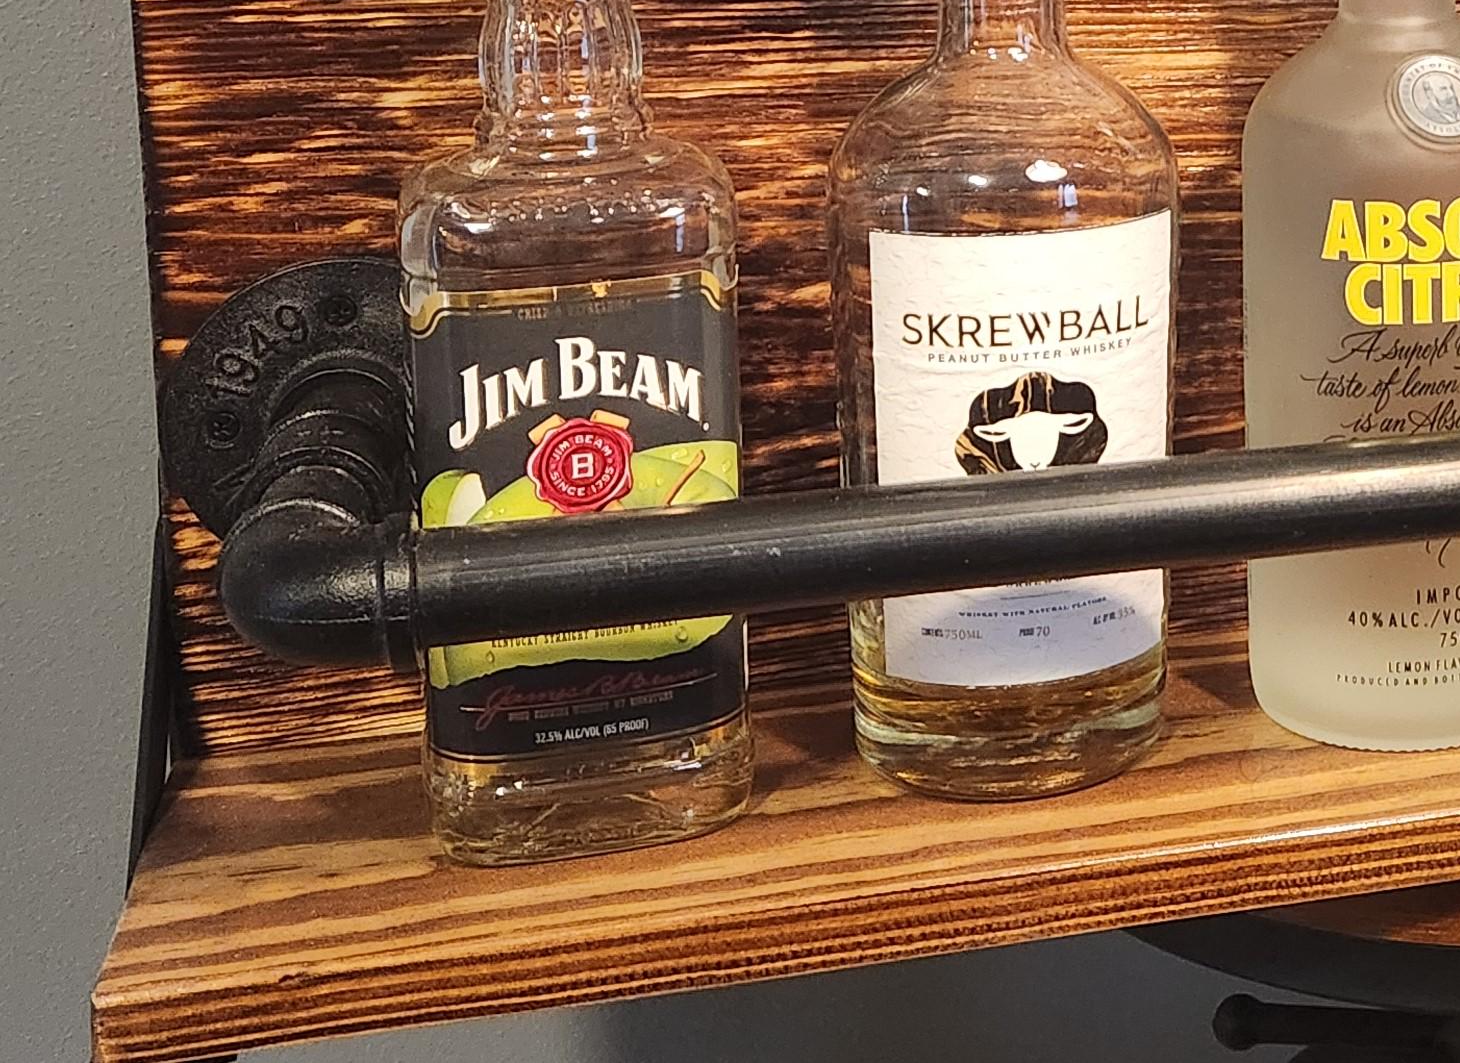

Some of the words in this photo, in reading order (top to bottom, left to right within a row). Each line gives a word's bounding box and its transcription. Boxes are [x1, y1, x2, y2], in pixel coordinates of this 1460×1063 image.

[902, 295, 1149, 347] SKREWBALL
[927, 352, 990, 364] PEANUT
[999, 349, 1062, 363] BUTTER
[1070, 337, 1133, 357] WHISKEY
[1327, 327, 1388, 364] A
[1375, 324, 1458, 368] superb
[449, 358, 551, 450] JIM
[554, 336, 702, 422] BEAM
[1300, 371, 1367, 399] taste
[1367, 367, 1402, 414] of
[1341, 410, 1378, 434] is
[1379, 416, 1408, 434] an
[552, 440, 571, 461] JIM
[574, 434, 613, 457] BEAM
[571, 452, 595, 480] B
[549, 471, 586, 496] SINCE
[591, 466, 614, 494] 1795
[1036, 627, 1051, 638] 70
[1336, 674, 1400, 686] PRODUCED
[1405, 677, 1428, 686] AND
[1388, 661, 1431, 674] LEMON
[535, 731, 563, 745] 32.5%
[564, 725, 601, 740] ALC/VOL
[603, 724, 618, 739] (65
[619, 718, 650, 733] PROOF)
